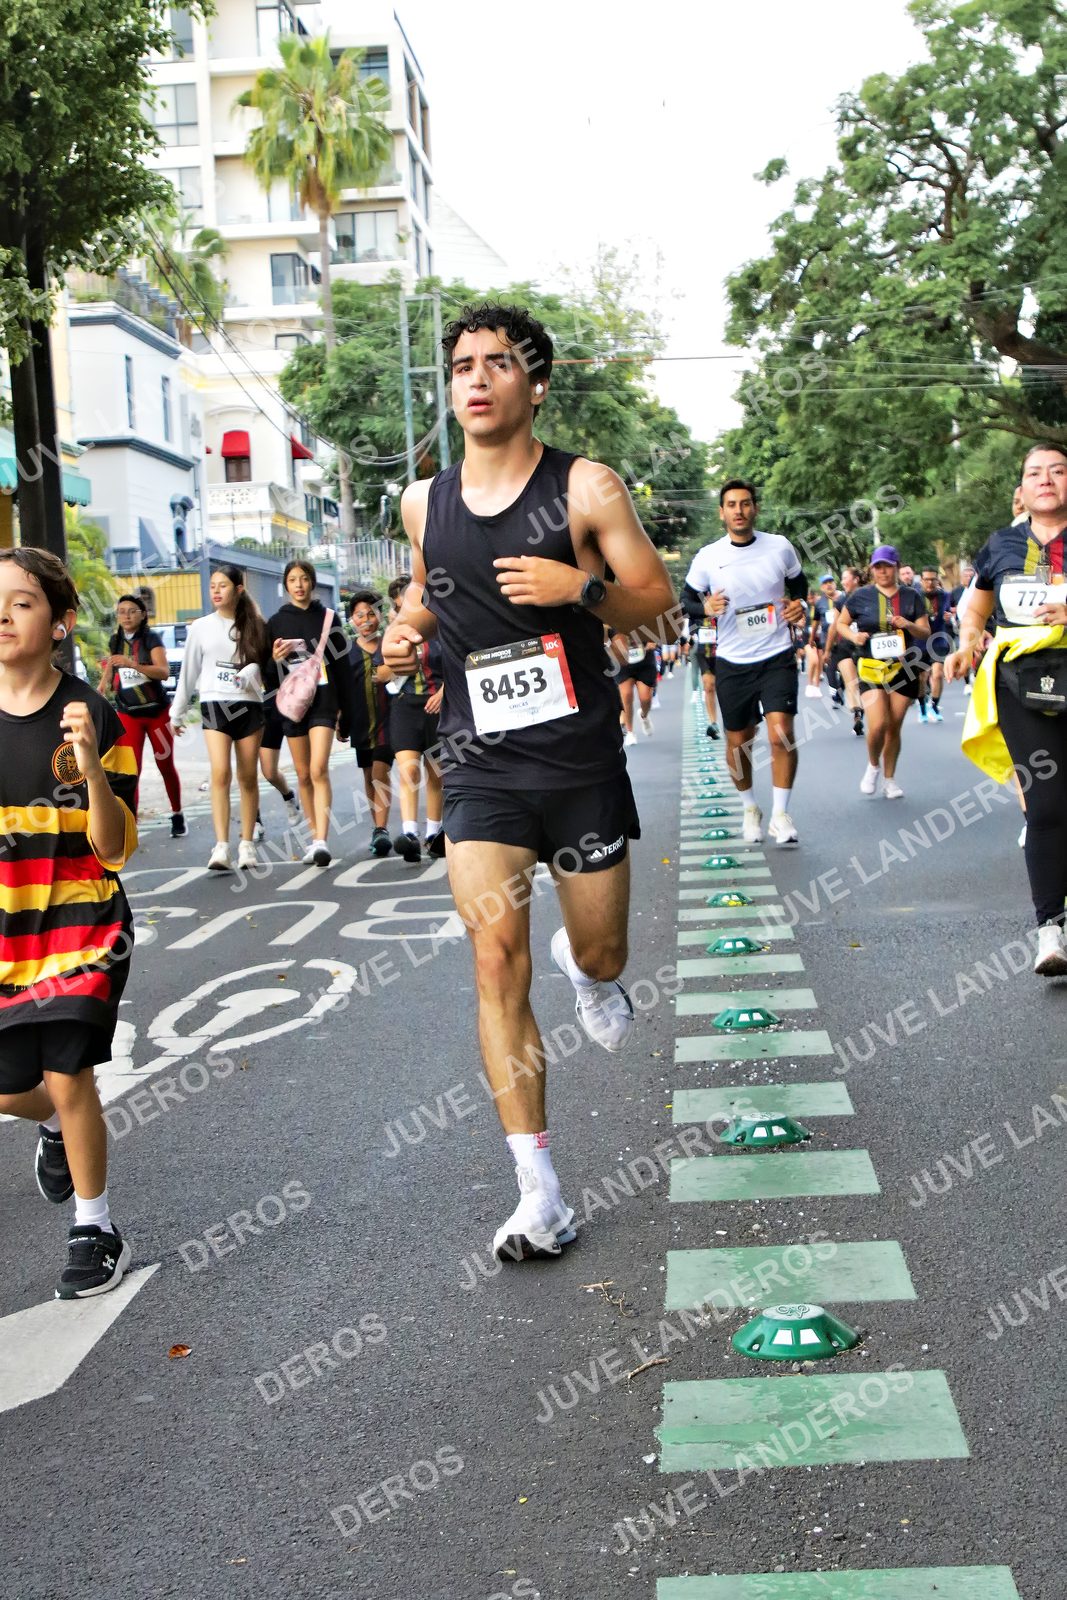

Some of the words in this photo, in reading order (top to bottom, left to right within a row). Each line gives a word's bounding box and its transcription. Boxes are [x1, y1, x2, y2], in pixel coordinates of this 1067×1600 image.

[1017, 590, 1048, 607] 772
[747, 613, 767, 627] 806
[876, 638, 898, 650] 2508
[480, 666, 548, 704] 8453
[602, 834, 625, 856] TERRE
